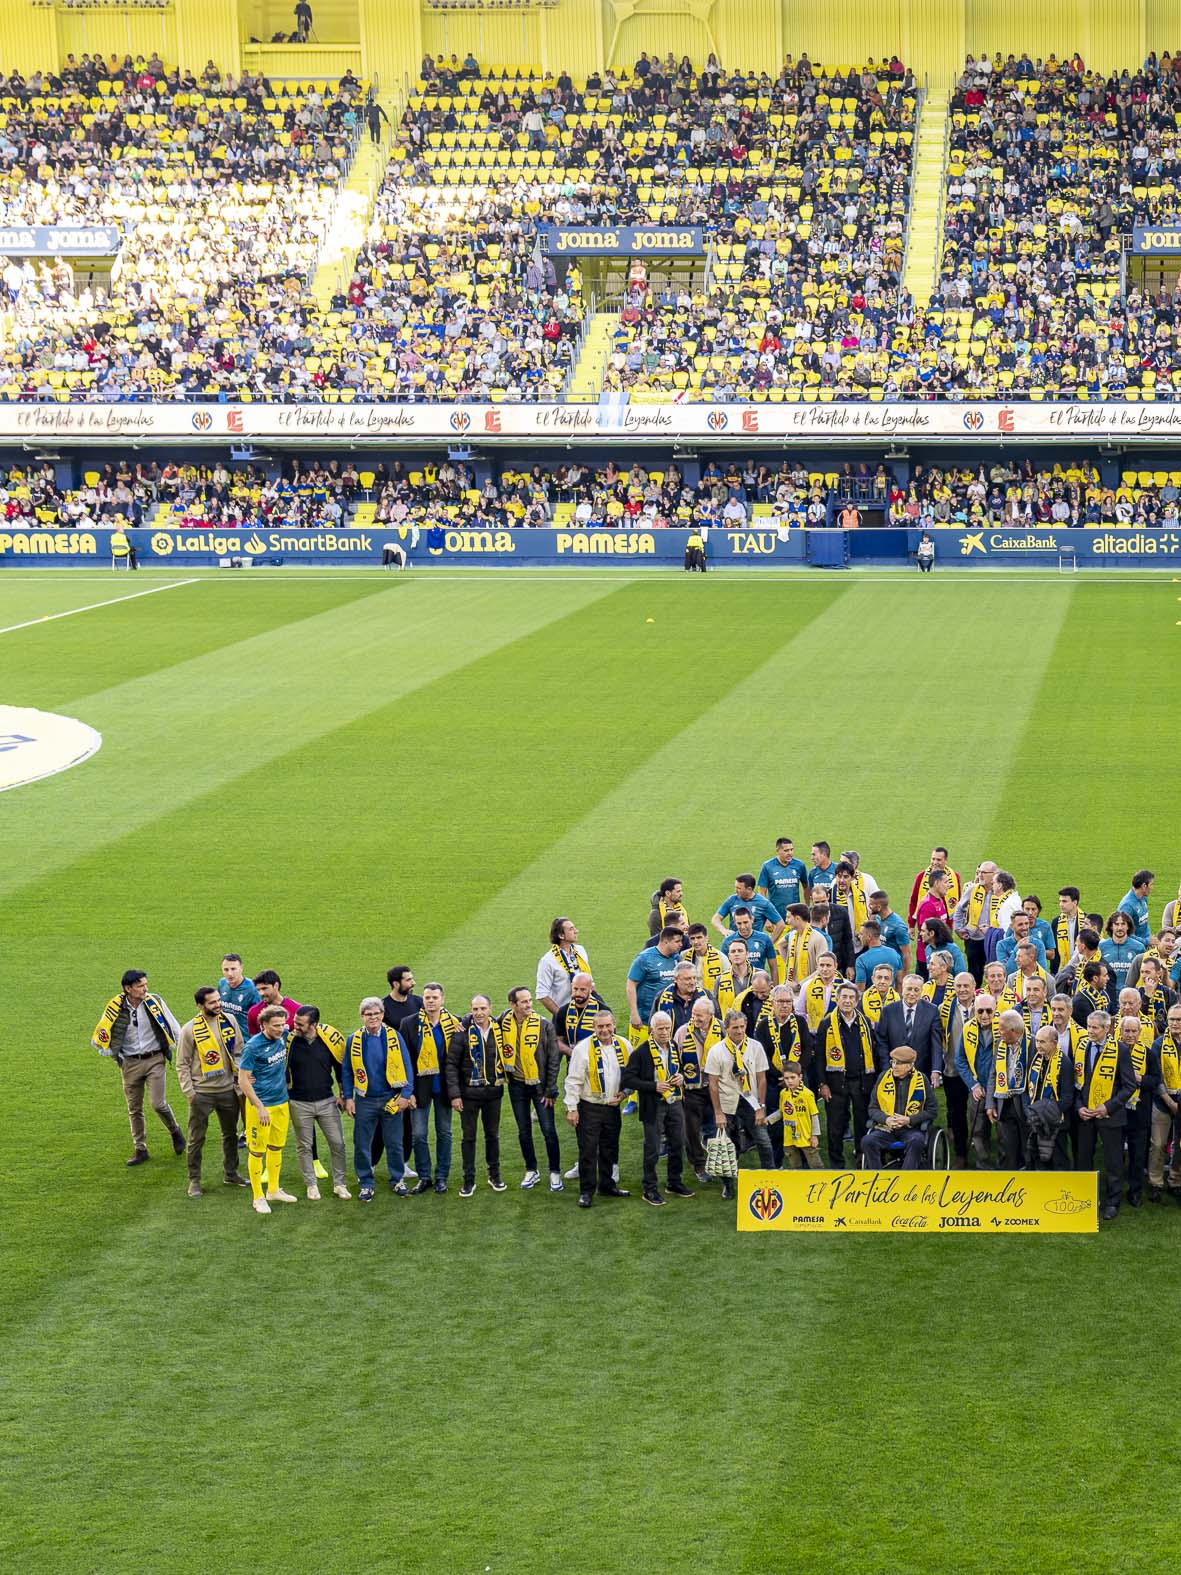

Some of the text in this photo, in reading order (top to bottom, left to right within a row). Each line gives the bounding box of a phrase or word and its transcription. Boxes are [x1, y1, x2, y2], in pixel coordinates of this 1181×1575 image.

[18, 412, 32, 426] El
[33, 407, 74, 428] Partido
[88, 412, 104, 426] las
[105, 408, 155, 432] Leyendas
[278, 412, 292, 426] El
[294, 407, 335, 428] Partido
[349, 412, 365, 426] las
[366, 408, 416, 432] Leyendas
[536, 412, 550, 426] El
[551, 407, 592, 428] Partido
[623, 408, 673, 432] Leyendas
[792, 412, 806, 426] El
[808, 407, 849, 428] Partido
[863, 412, 879, 426] las
[880, 408, 930, 432] Leyendas
[1050, 411, 1064, 424] El
[1065, 406, 1106, 428] Partido
[1120, 411, 1136, 425] las
[0, 533, 97, 554] PAMESA
[176, 533, 240, 555] LaLiga
[269, 534, 372, 552] SmartBank
[557, 533, 656, 554] PAMESA
[727, 533, 777, 554] TAU
[990, 534, 1058, 549] CaixaBank
[1093, 534, 1157, 554] altadia
[806, 1172, 1027, 1216] El Partido de las Leyendas
[849, 1217, 882, 1225] CaixaBank
[1005, 1218, 1040, 1226] ZOOMEX
